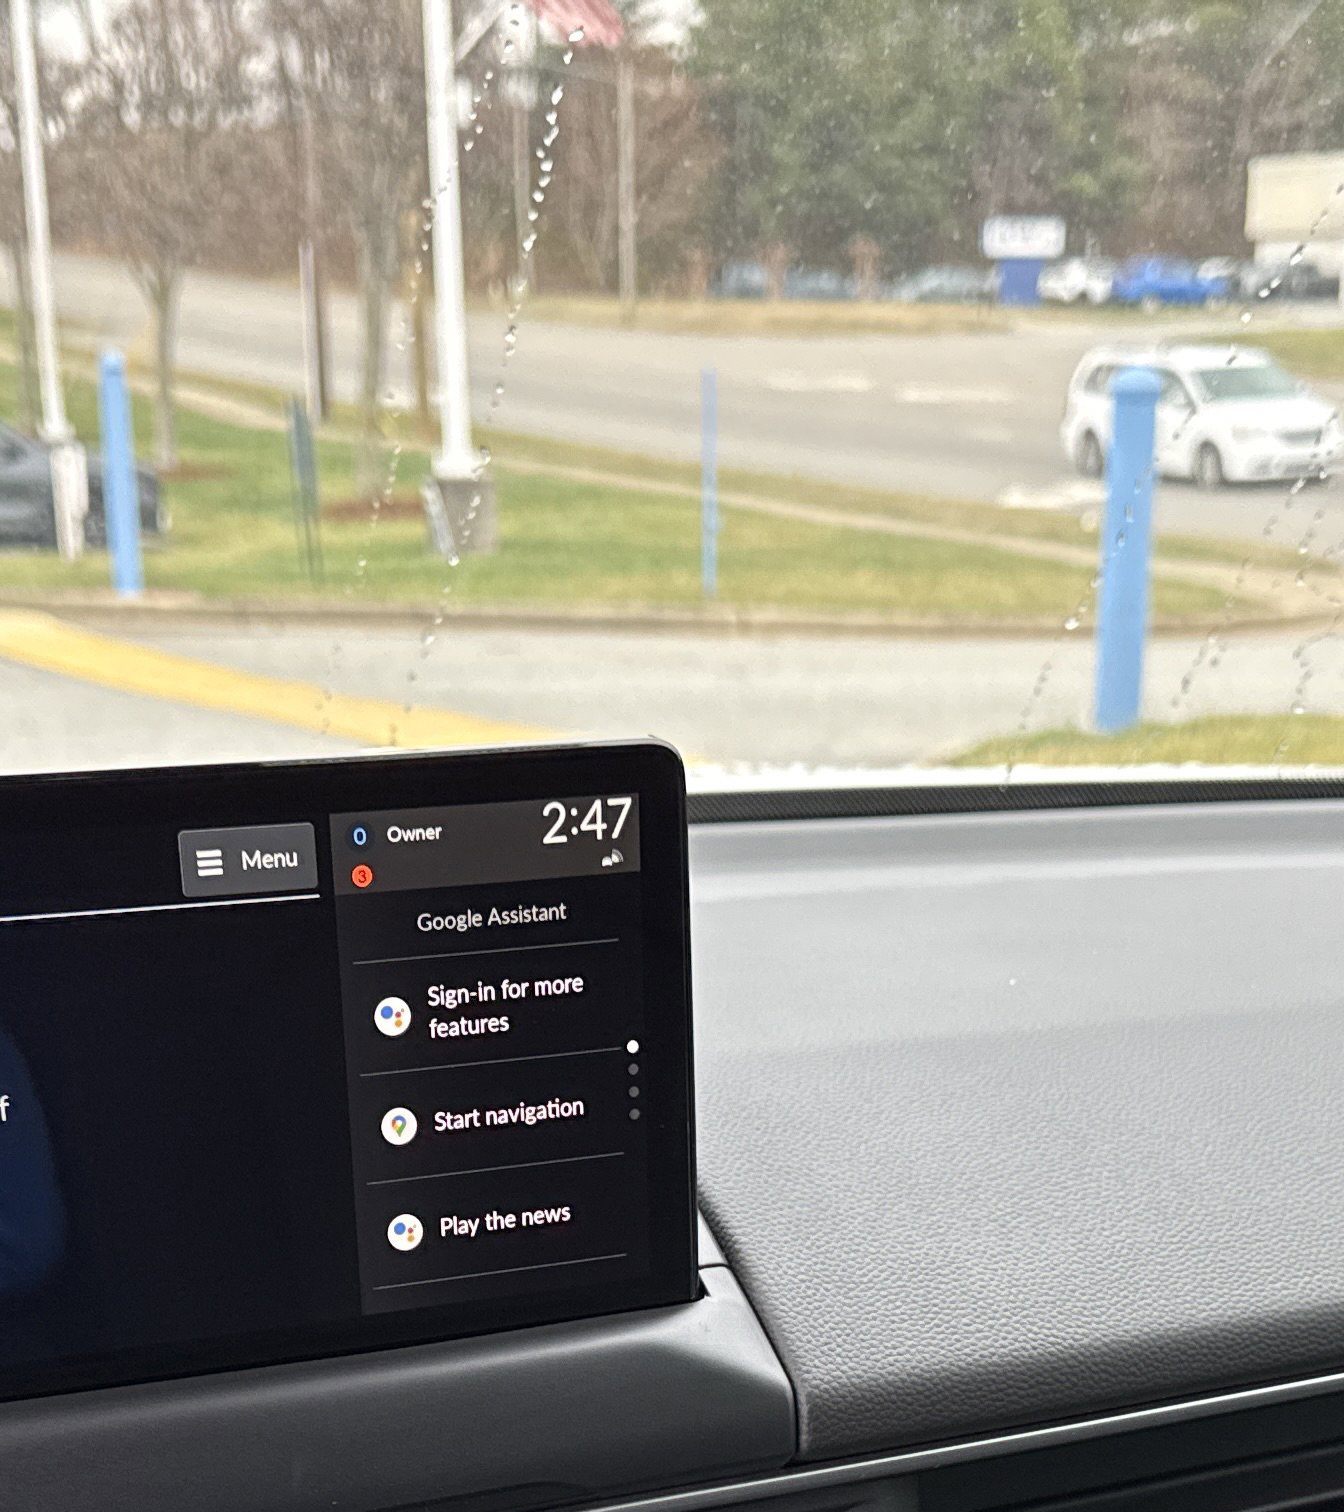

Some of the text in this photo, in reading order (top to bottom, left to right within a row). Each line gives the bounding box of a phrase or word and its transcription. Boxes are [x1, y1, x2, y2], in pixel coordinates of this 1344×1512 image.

[386, 825, 443, 843] Owner
[542, 796, 632, 845] 2:47
[241, 849, 299, 871] Menu
[416, 902, 567, 932] Google Assistant
[427, 976, 584, 1010] Sign-in for more
[428, 1015, 510, 1039] features
[434, 1098, 585, 1132] Start navigation
[440, 1206, 572, 1238] Play the news
